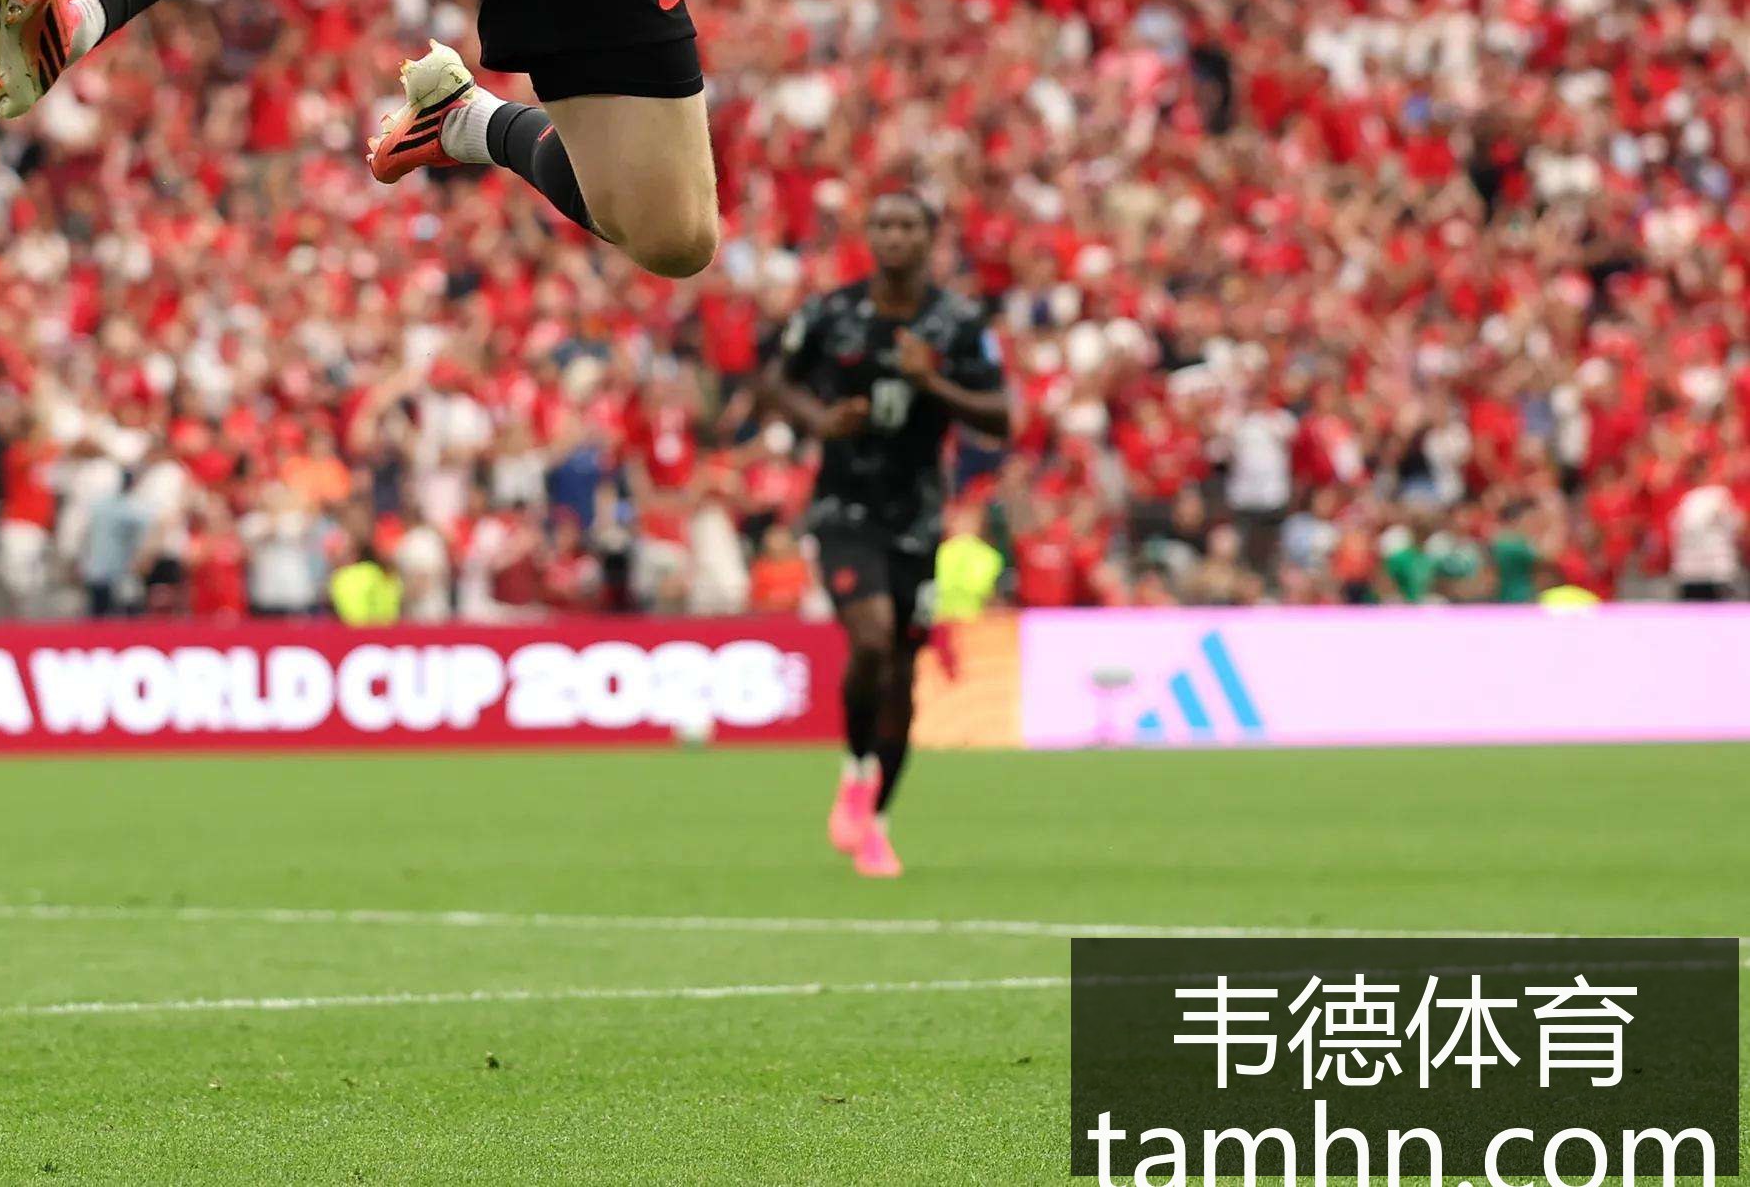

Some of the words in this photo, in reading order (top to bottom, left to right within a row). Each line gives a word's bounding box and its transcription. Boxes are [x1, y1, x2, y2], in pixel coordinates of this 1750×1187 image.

[28, 644, 336, 733] WORLD
[336, 642, 506, 732] CUP
[505, 639, 788, 729] 2026
